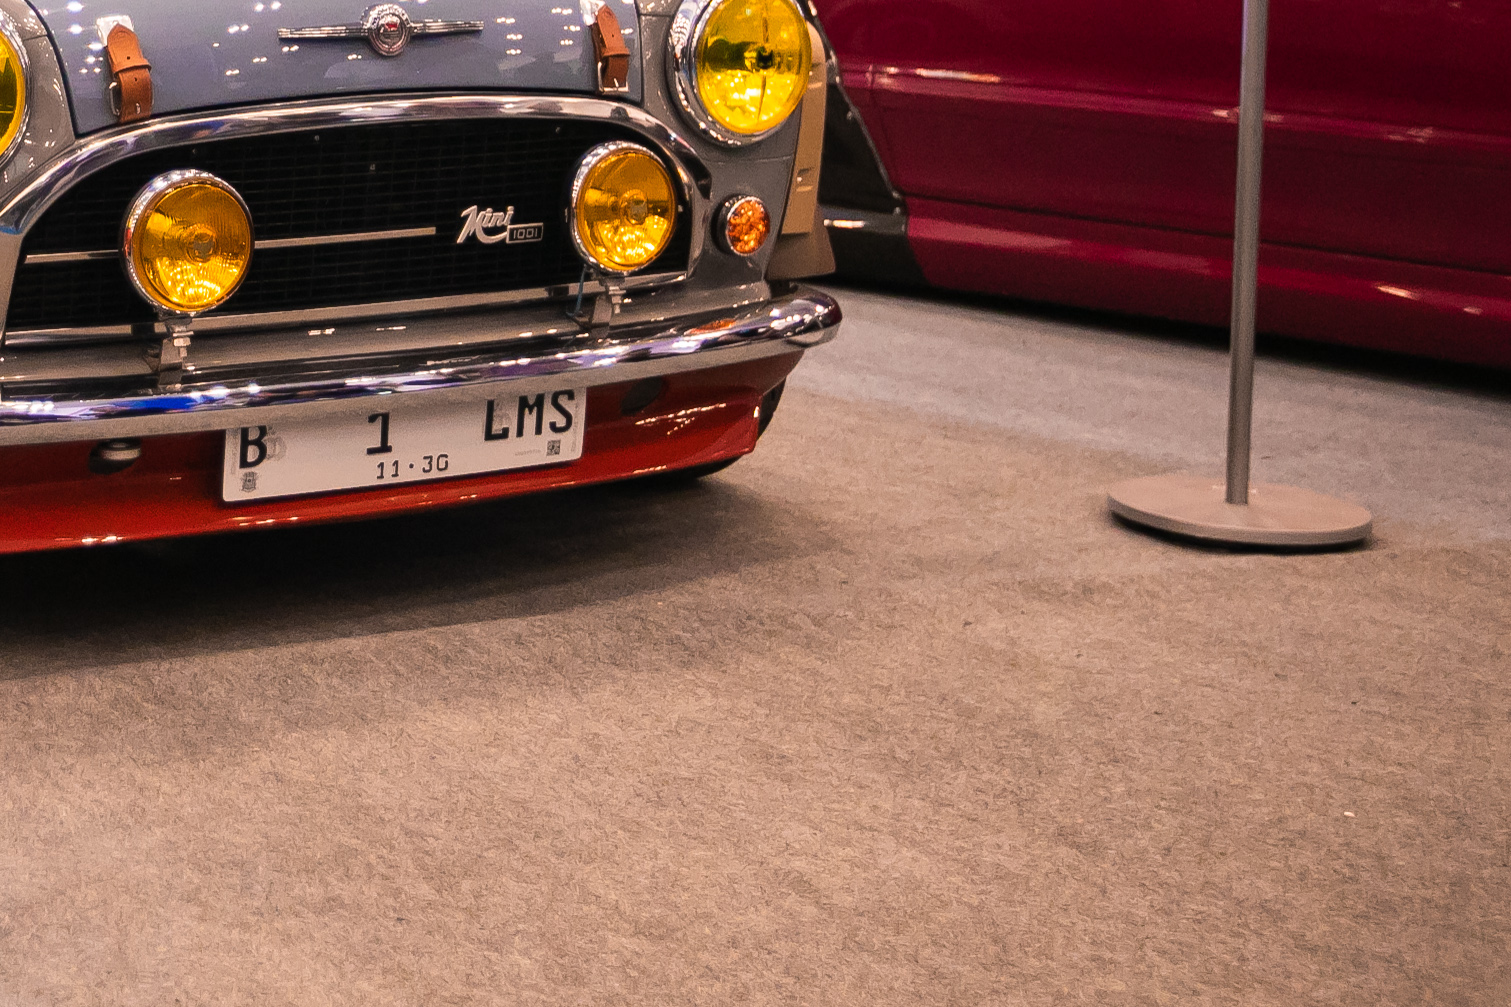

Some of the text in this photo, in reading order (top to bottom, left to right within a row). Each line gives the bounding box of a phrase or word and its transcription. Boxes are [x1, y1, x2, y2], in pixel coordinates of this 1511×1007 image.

[456, 204, 515, 244] Mini
[513, 227, 538, 239] 1001
[239, 424, 268, 469] B
[366, 412, 393, 455] 1
[484, 389, 575, 442] LMS
